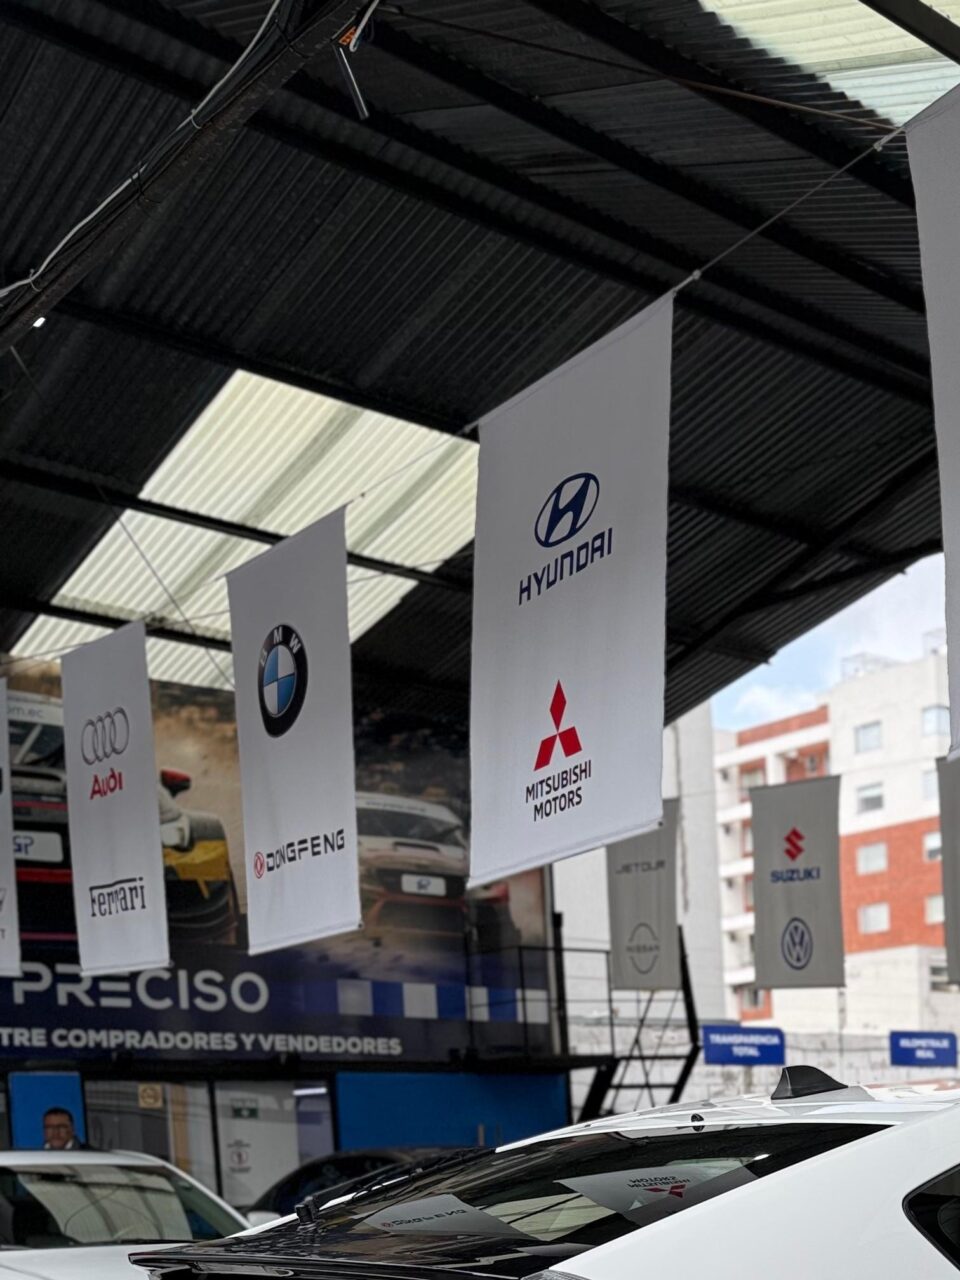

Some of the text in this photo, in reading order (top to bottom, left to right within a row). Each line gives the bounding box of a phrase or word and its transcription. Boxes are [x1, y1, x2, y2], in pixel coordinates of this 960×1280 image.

[518, 527, 613, 606] HYUNDAI
[260, 626, 303, 667] BMW
[90, 768, 123, 800] Audi
[525, 759, 592, 804] MITSUBISHI
[533, 787, 583, 822] MOTORS
[266, 828, 345, 872] DONGFENG
[770, 866, 821, 883] SUZUKI
[89, 877, 147, 917] Ferrari
[12, 961, 270, 1013] PRECISO
[51, 1028, 238, 1051] COMPRADORES
[241, 1032, 260, 1050] Y
[258, 1033, 403, 1055] VENDEDORES
[709, 1034, 780, 1045] TRANSPARENCIA
